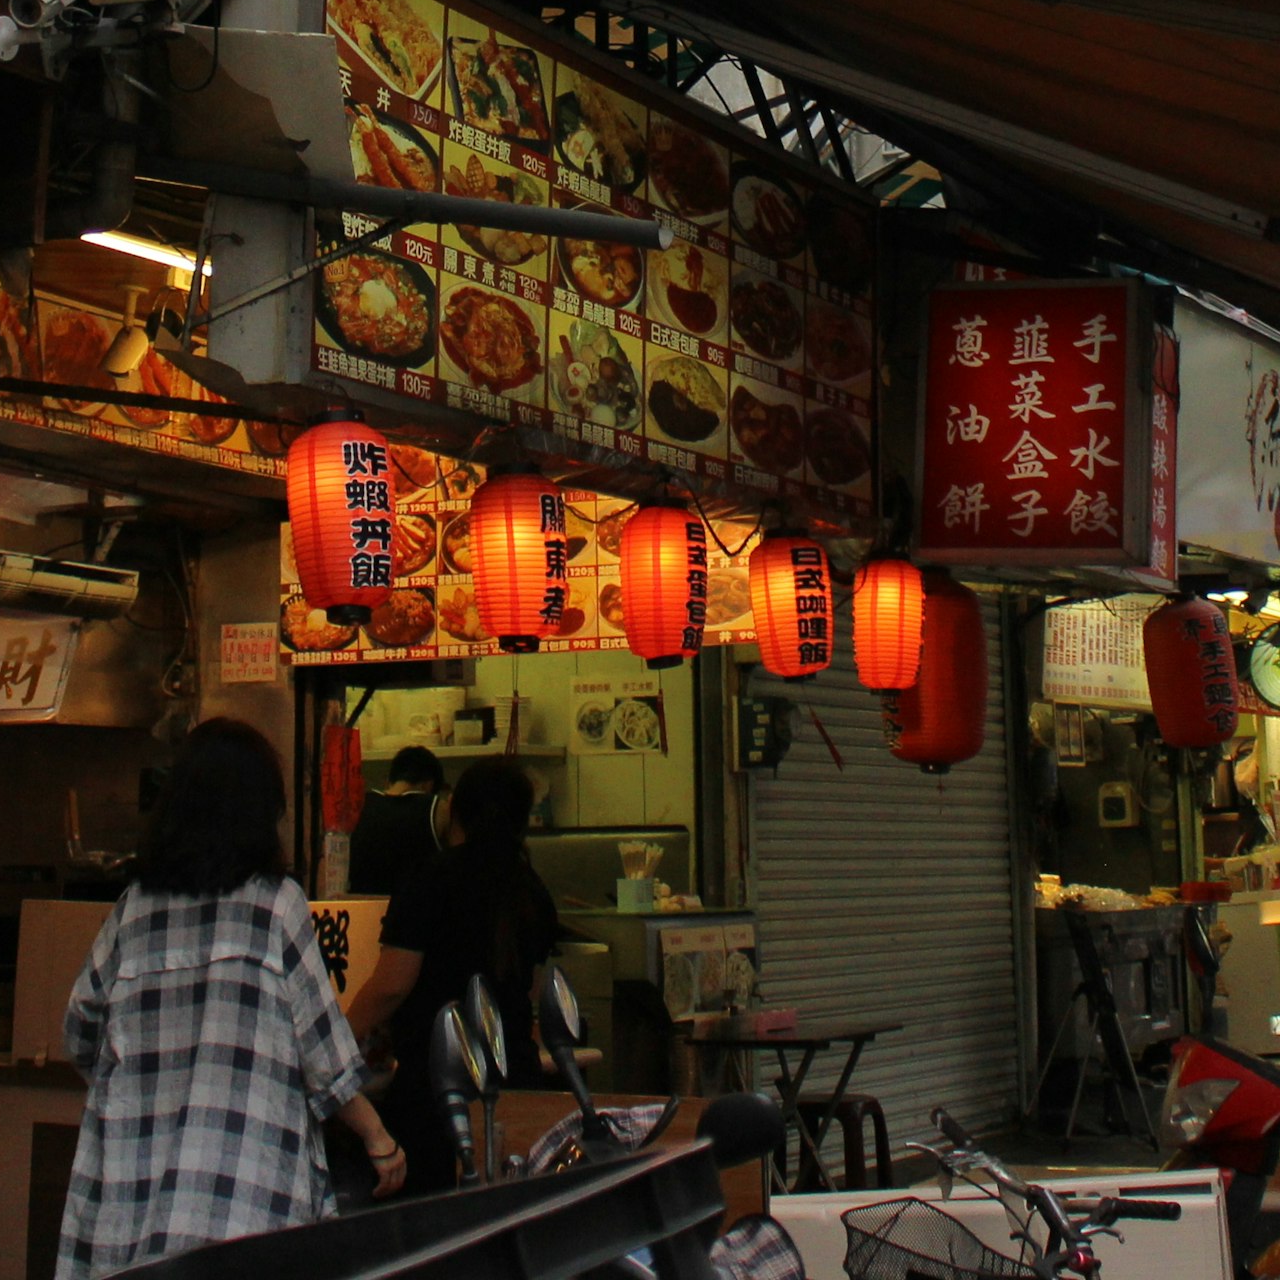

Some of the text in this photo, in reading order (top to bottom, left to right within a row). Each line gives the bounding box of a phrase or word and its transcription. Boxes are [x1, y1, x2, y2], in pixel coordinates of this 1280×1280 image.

[521, 152, 548, 179] 120元
[404, 237, 434, 265] 120元
[618, 311, 642, 337] 120元
[650, 322, 726, 367] 日式蛋包飯 90元
[401, 373, 432, 400] 130元
[1062, 313, 1121, 539] 手工水餃
[341, 440, 392, 589] 炸蝦丼飯
